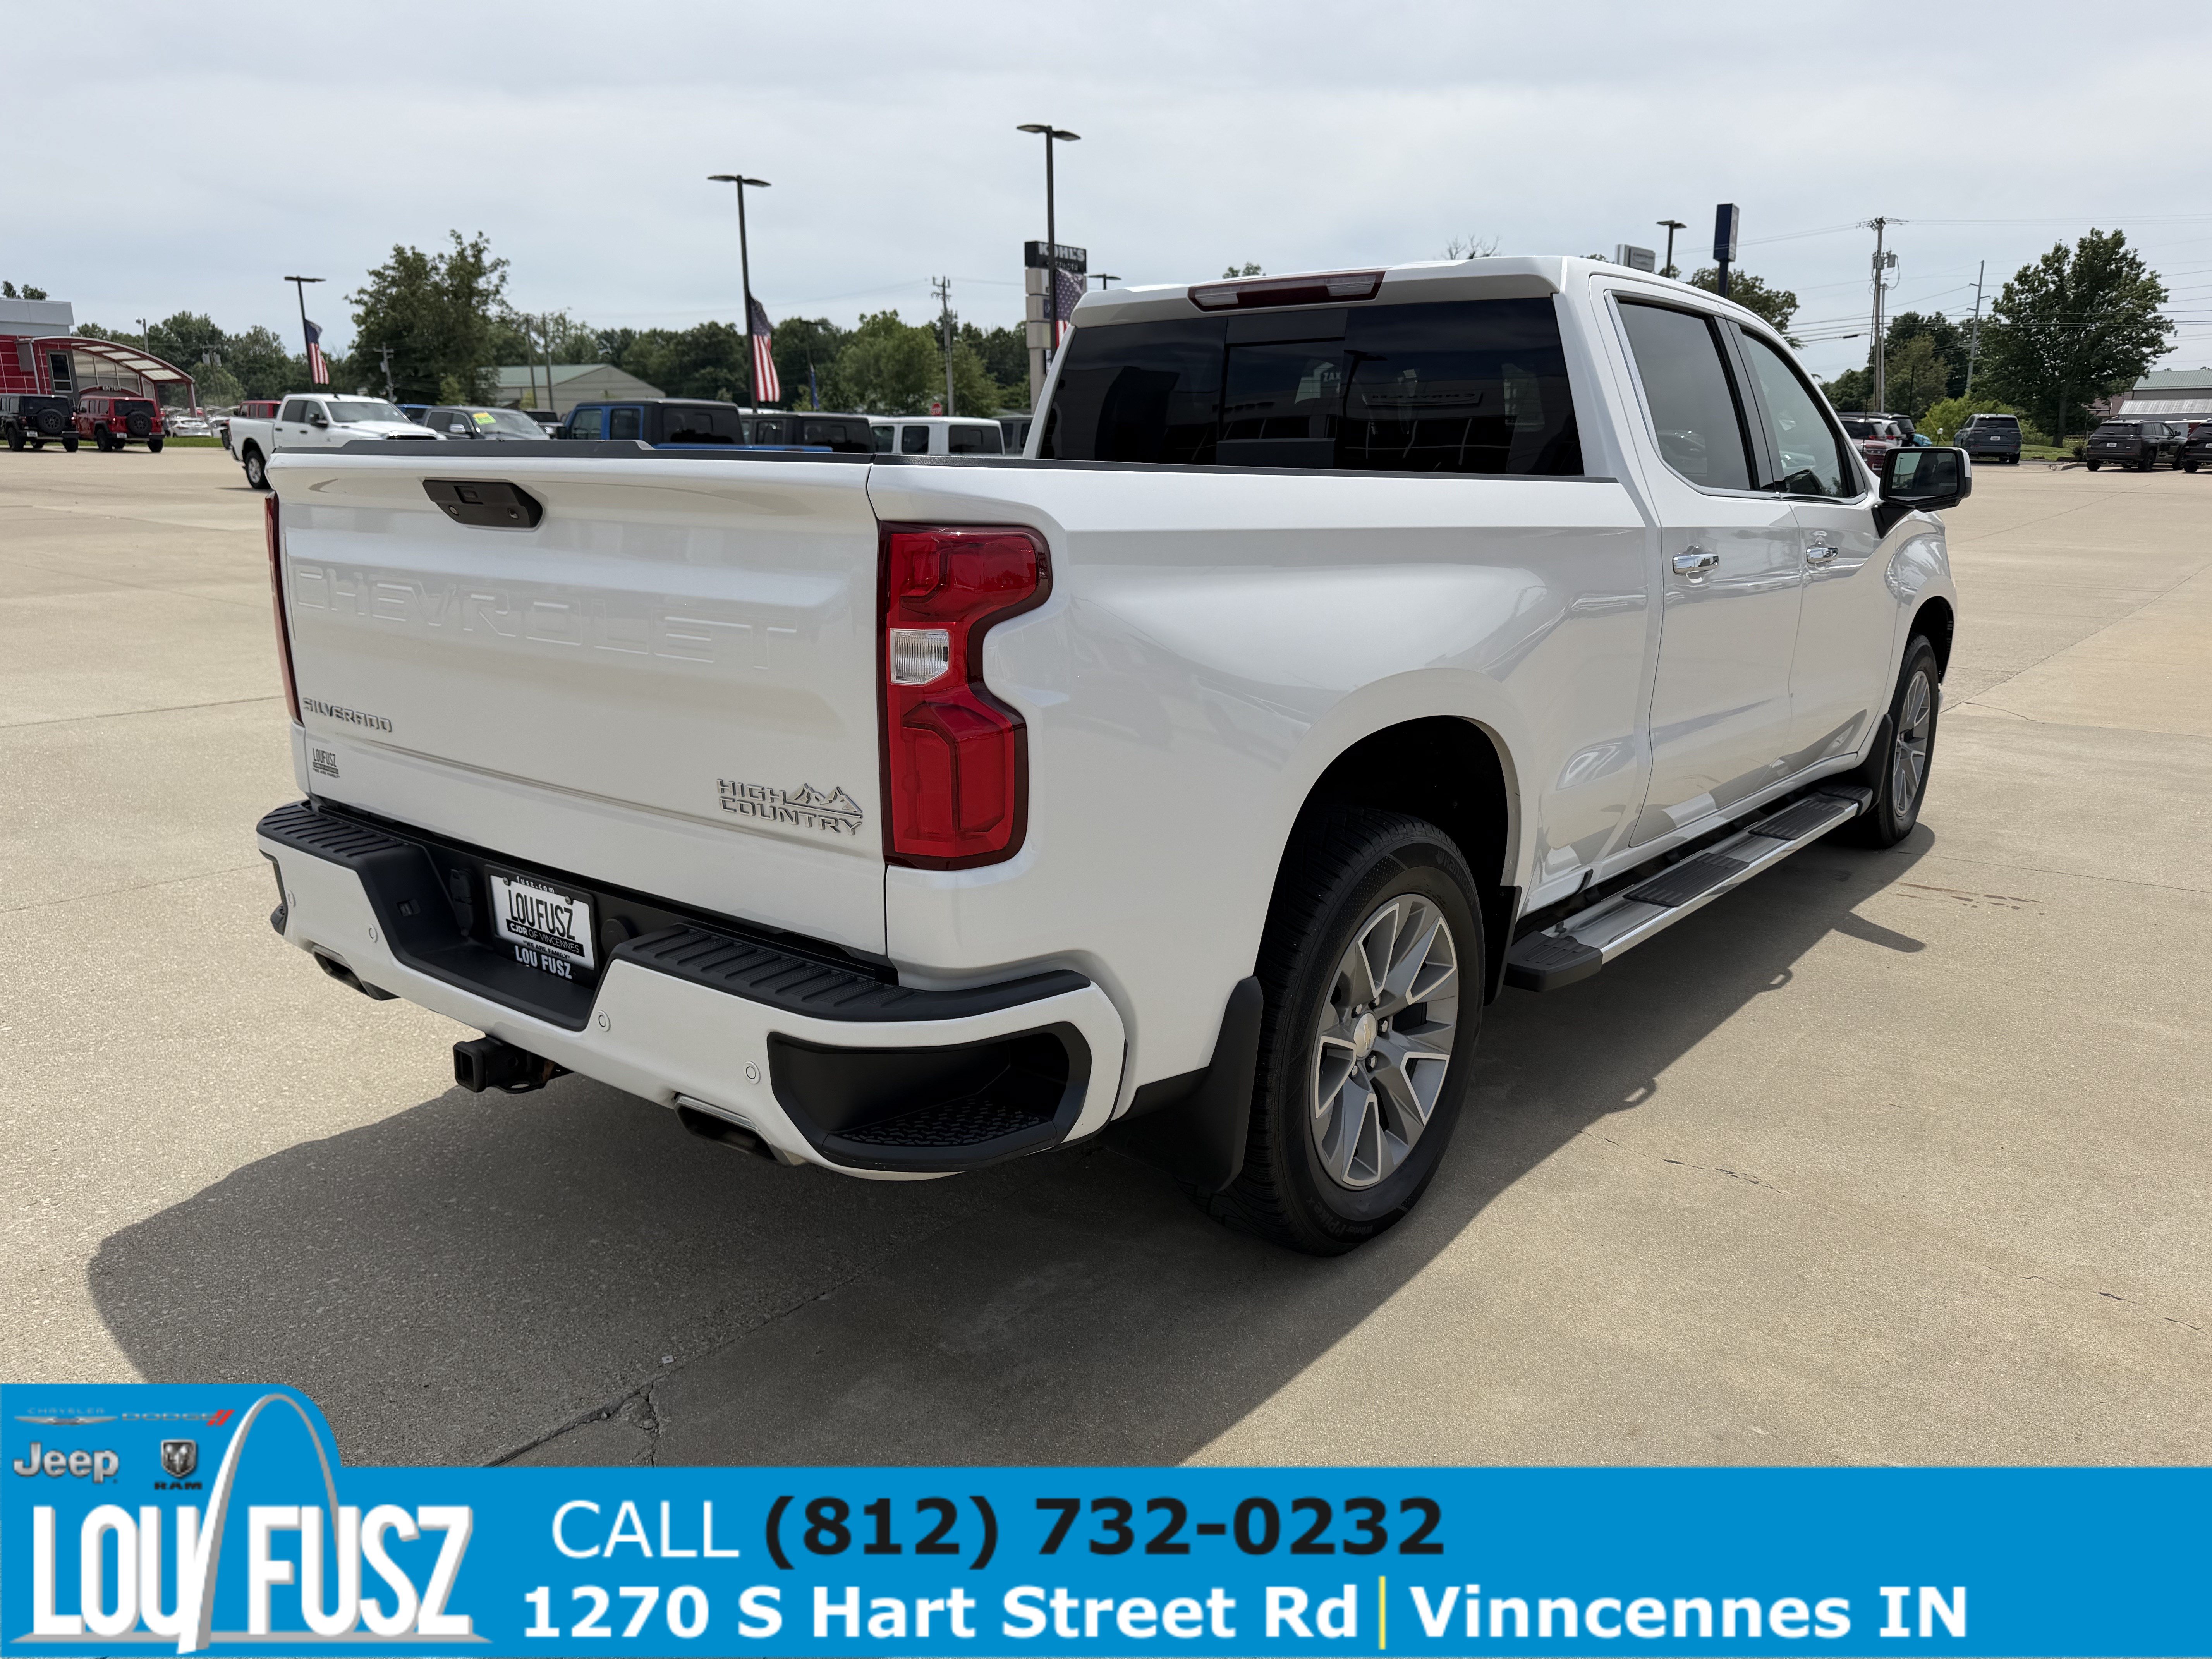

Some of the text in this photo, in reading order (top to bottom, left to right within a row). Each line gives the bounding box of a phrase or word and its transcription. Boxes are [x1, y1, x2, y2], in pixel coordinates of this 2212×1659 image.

[293, 565, 797, 670] CHEVROLET
[303, 697, 393, 733] SILVERADO
[716, 778, 786, 805] HIGH
[719, 795, 863, 835] COUNTRY
[517, 876, 555, 893] fusz.com
[510, 922, 580, 953] CJDR OF VINCENNES
[515, 945, 572, 980] LOU FUSZ
